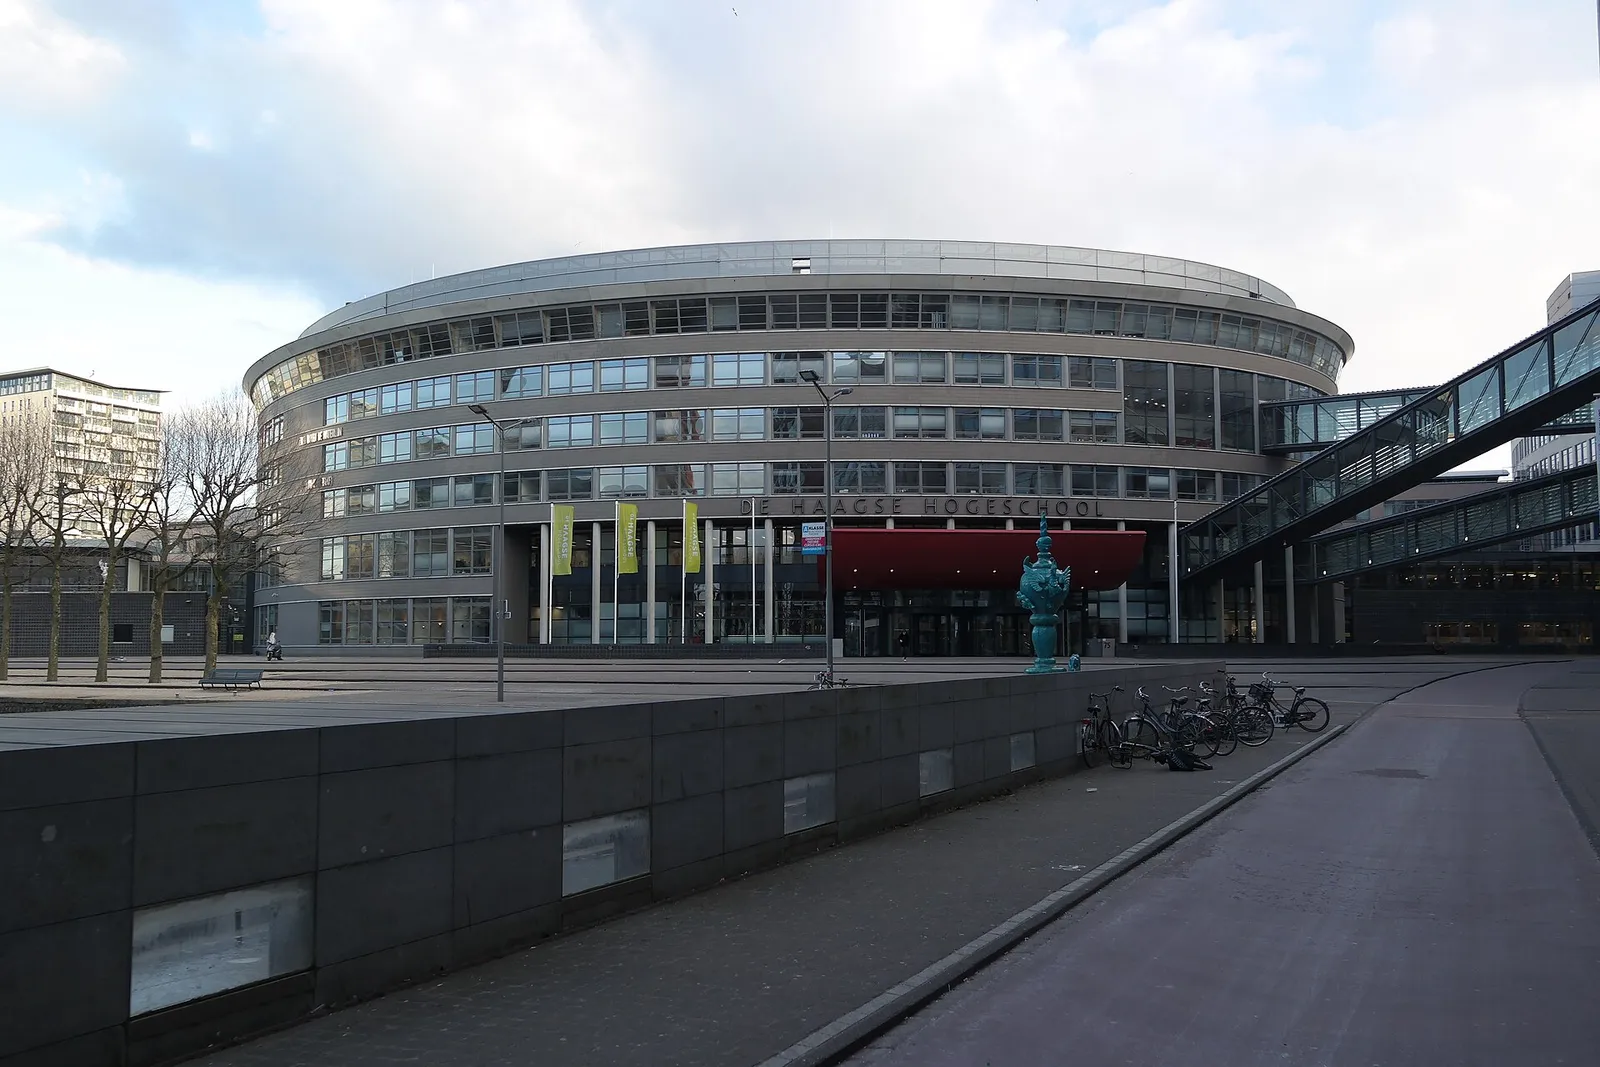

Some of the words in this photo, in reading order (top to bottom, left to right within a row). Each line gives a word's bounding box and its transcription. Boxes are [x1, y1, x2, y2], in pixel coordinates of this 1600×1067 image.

[741, 499, 769, 514] DE
[792, 498, 901, 515] HAAGSE
[924, 498, 1103, 517] HOGESCHOOL
